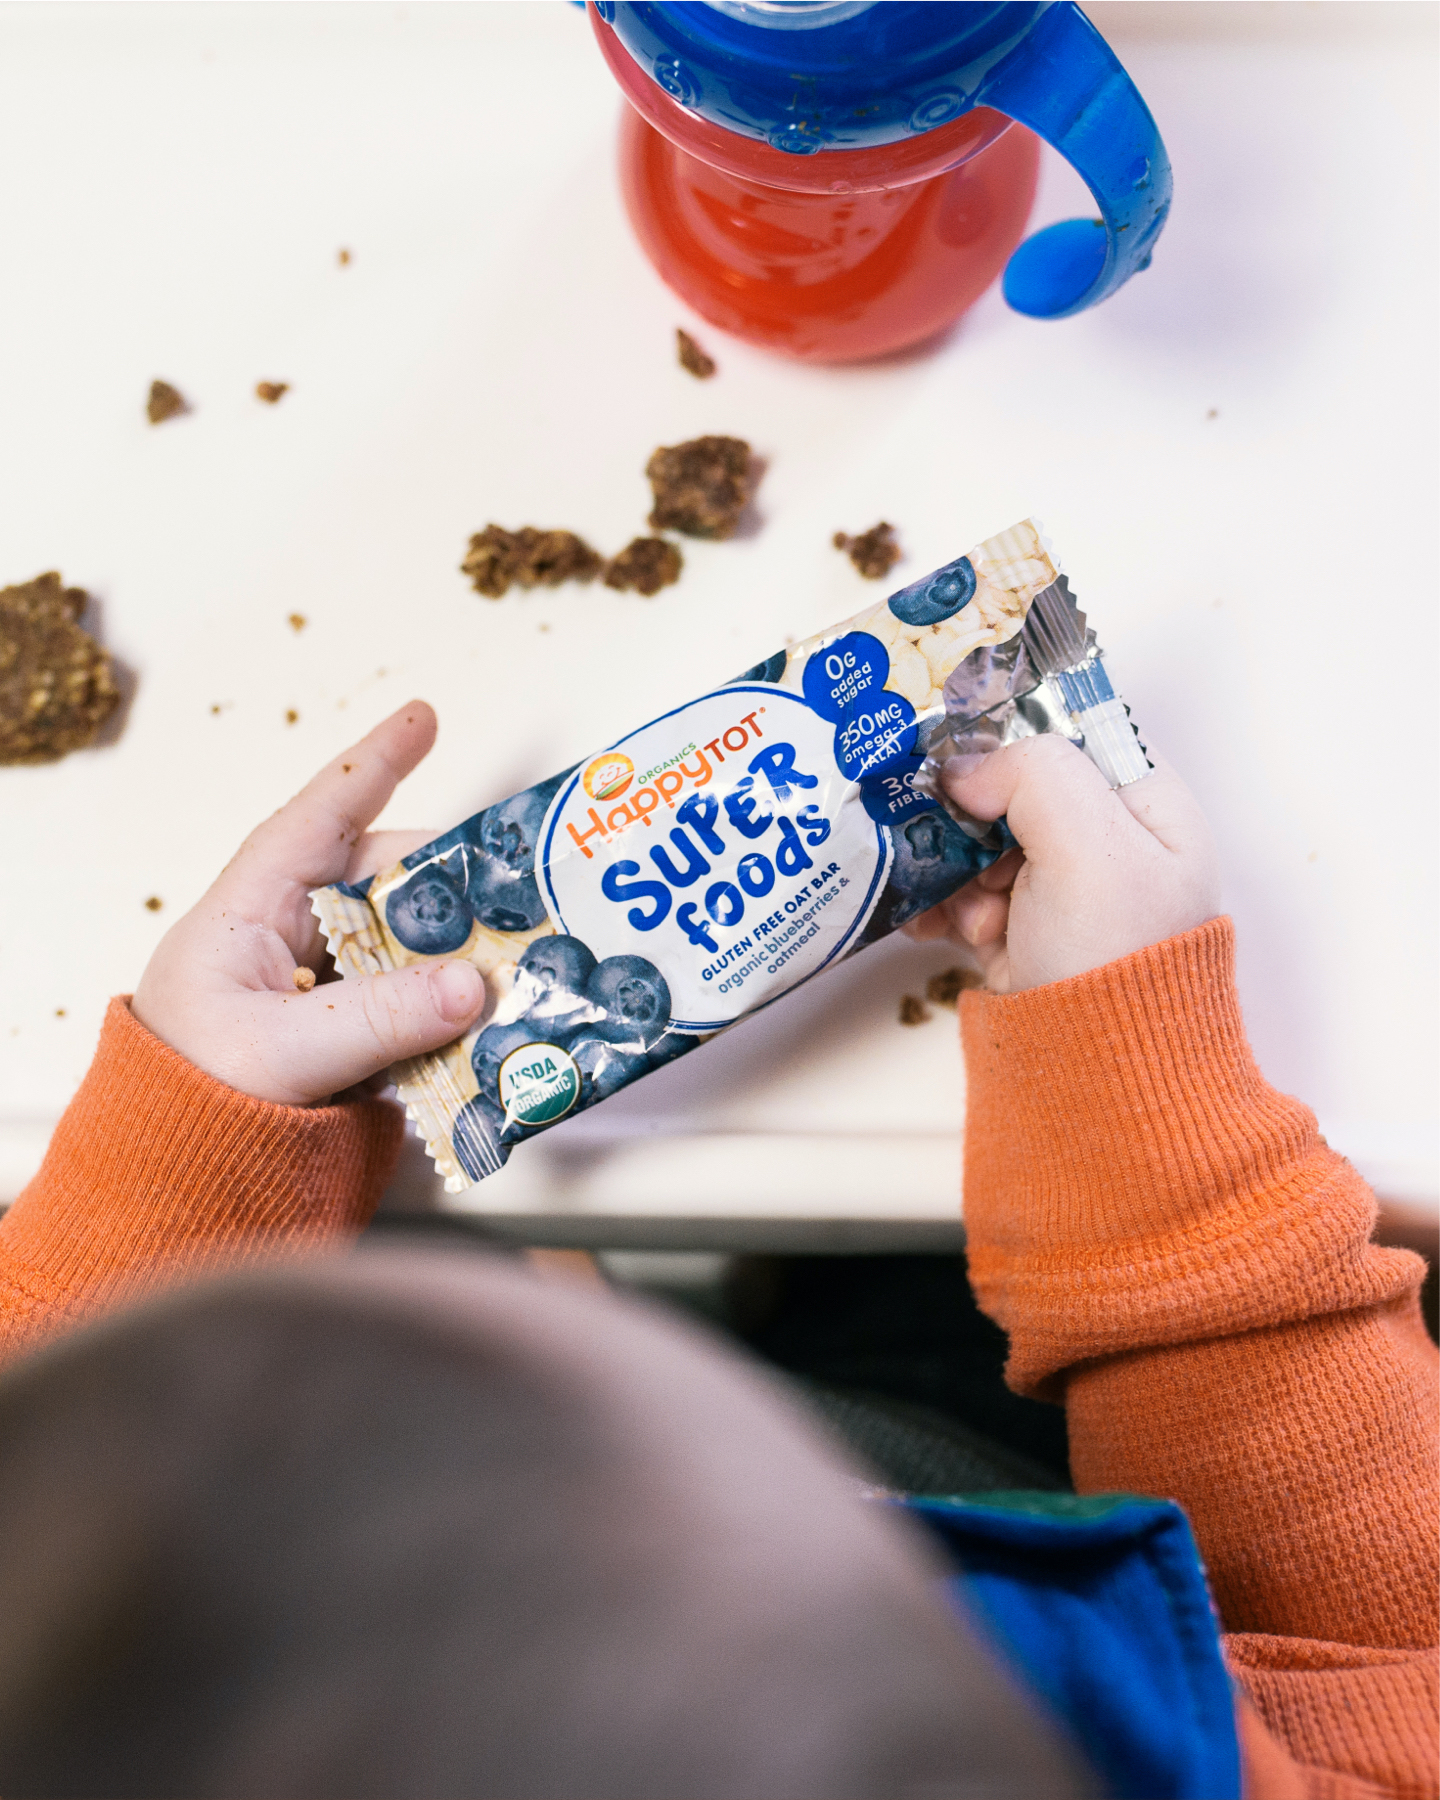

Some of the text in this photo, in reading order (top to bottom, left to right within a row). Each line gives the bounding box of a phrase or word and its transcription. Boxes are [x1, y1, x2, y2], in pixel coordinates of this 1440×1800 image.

[825, 651, 856, 680] 0G
[830, 661, 872, 699] added
[837, 674, 873, 708] sugar
[839, 703, 902, 752] 350MG
[844, 718, 907, 763] omega-3
[637, 742, 697, 785] ORGANICS
[676, 804, 831, 954] foods
[701, 862, 841, 981] GLUTEN FREE OAT BAR
[718, 876, 850, 994] organic blueberries &
[767, 922, 821, 974] oatmeal
[509, 1056, 557, 1090] USDA
[515, 1075, 572, 1114] ORGANIC
